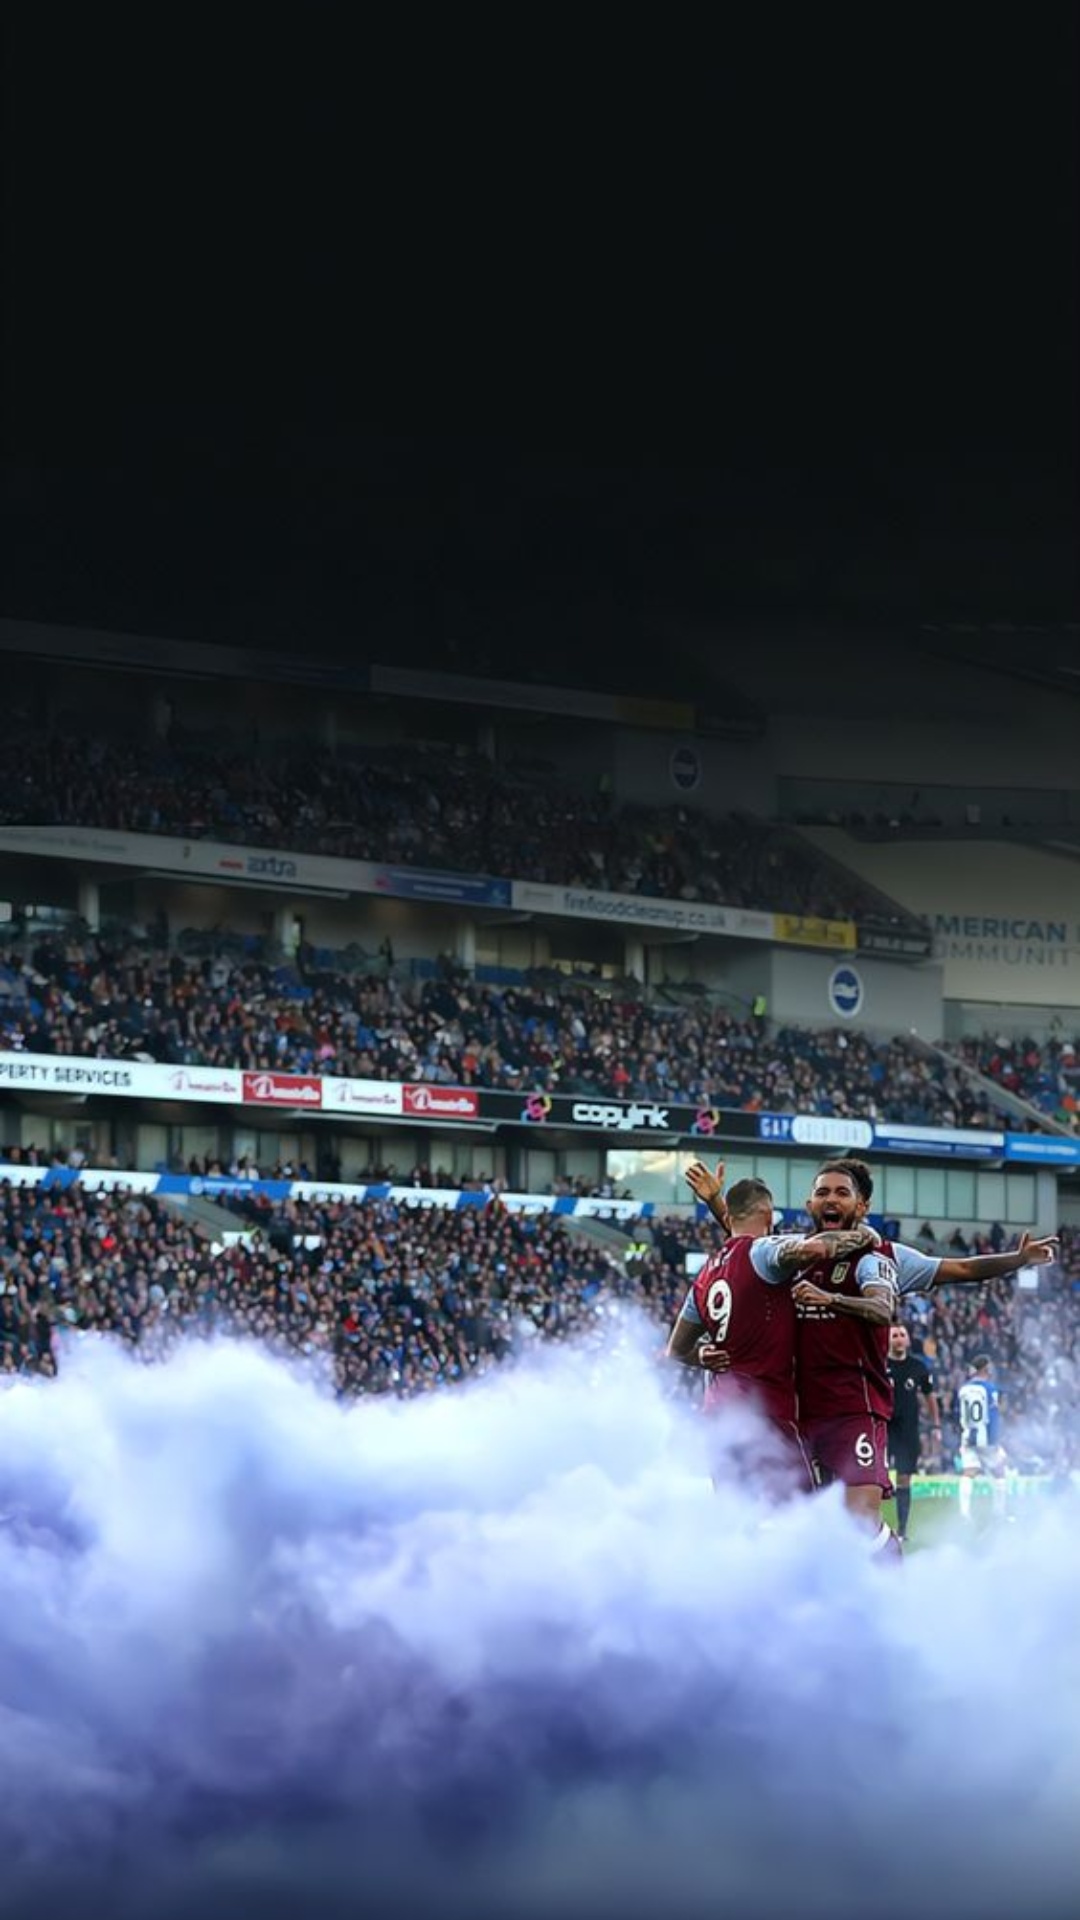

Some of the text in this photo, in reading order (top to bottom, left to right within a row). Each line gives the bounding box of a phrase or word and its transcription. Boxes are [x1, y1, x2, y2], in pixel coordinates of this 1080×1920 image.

[934, 913, 1066, 942] MERICAN
[932, 940, 1080, 967] OMMUNIT
[54, 1066, 131, 1087] SERVICES
[760, 1117, 790, 1138] GAP
[706, 1278, 733, 1342] 9
[964, 1400, 983, 1422] 10
[855, 1432, 874, 1459] 6
